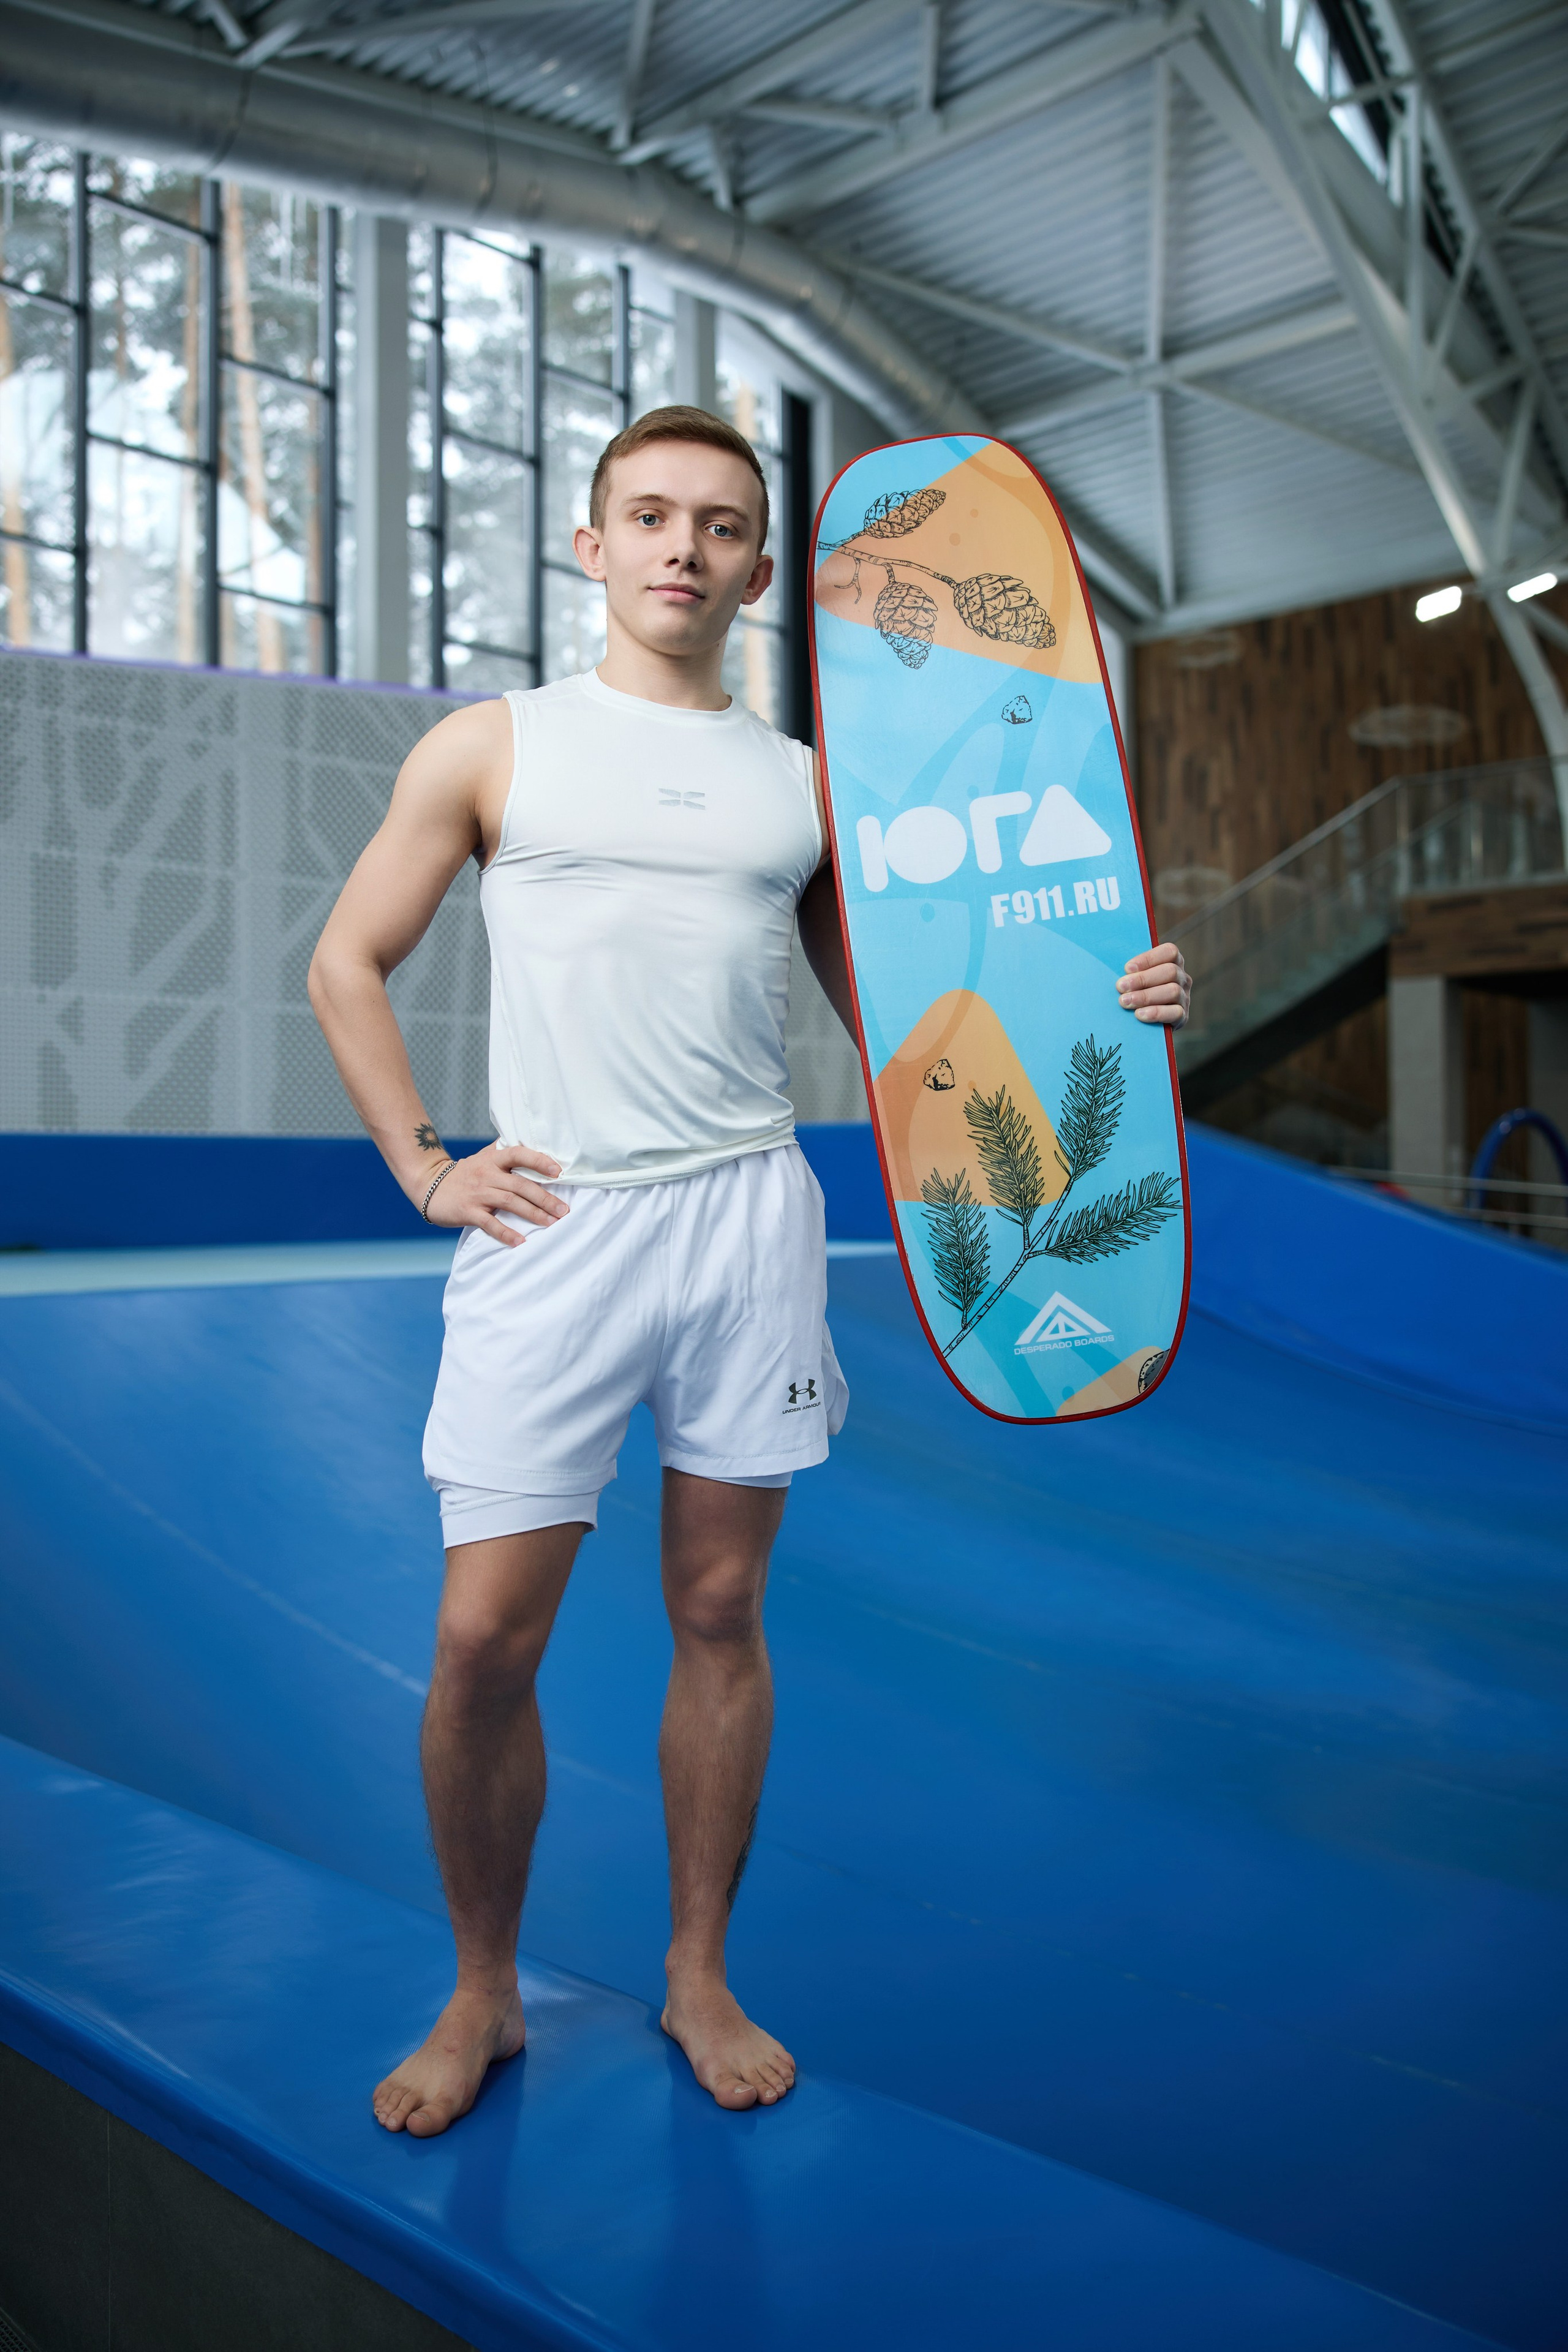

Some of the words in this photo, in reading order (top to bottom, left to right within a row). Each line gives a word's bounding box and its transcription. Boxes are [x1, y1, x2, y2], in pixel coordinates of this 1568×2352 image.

[990, 876, 1121, 928] F911.RU
[1014, 1340, 1072, 1355] DESPERADO
[1074, 1335, 1115, 1346] BOARDS
[802, 1401, 821, 1411] ARMOUR
